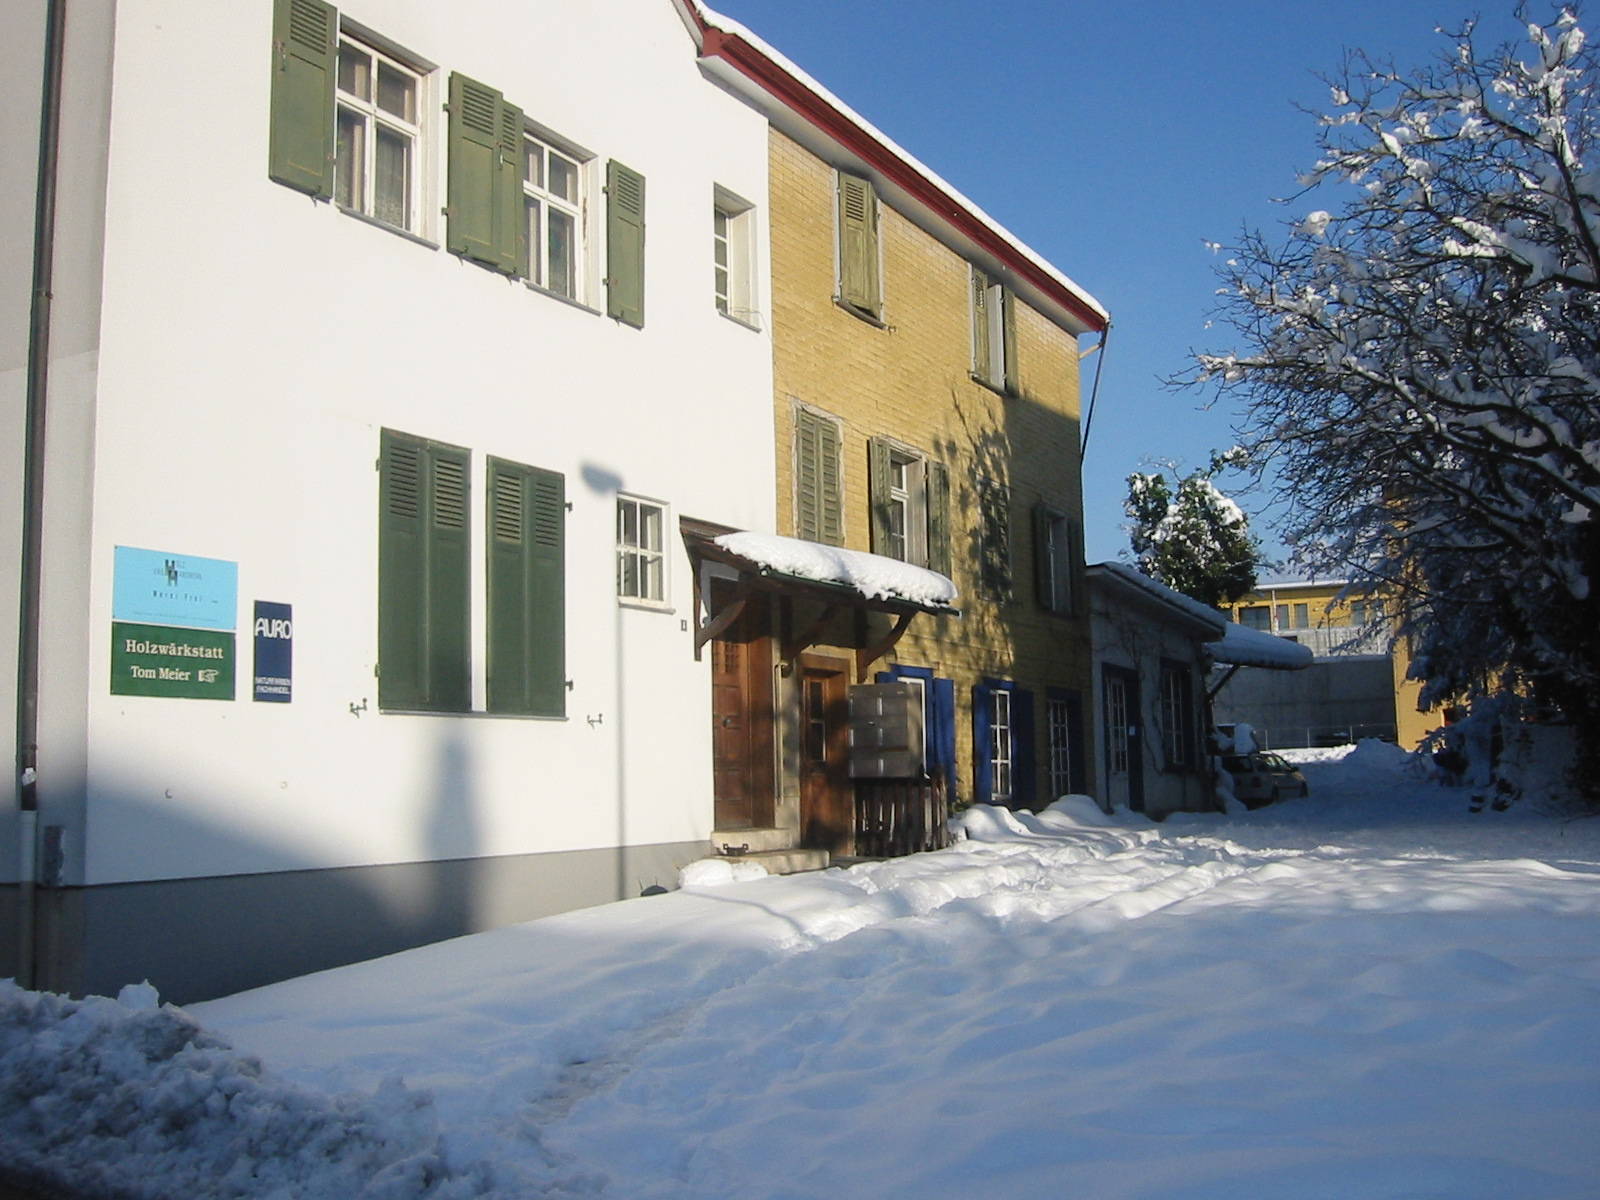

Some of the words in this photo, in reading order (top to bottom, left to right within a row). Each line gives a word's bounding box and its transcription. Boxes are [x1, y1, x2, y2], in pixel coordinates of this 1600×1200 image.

[255, 617, 292, 639] AURO
[125, 639, 224, 659] Holzwärkstatt
[130, 665, 156, 679] Tom
[158, 668, 191, 681] Meier
